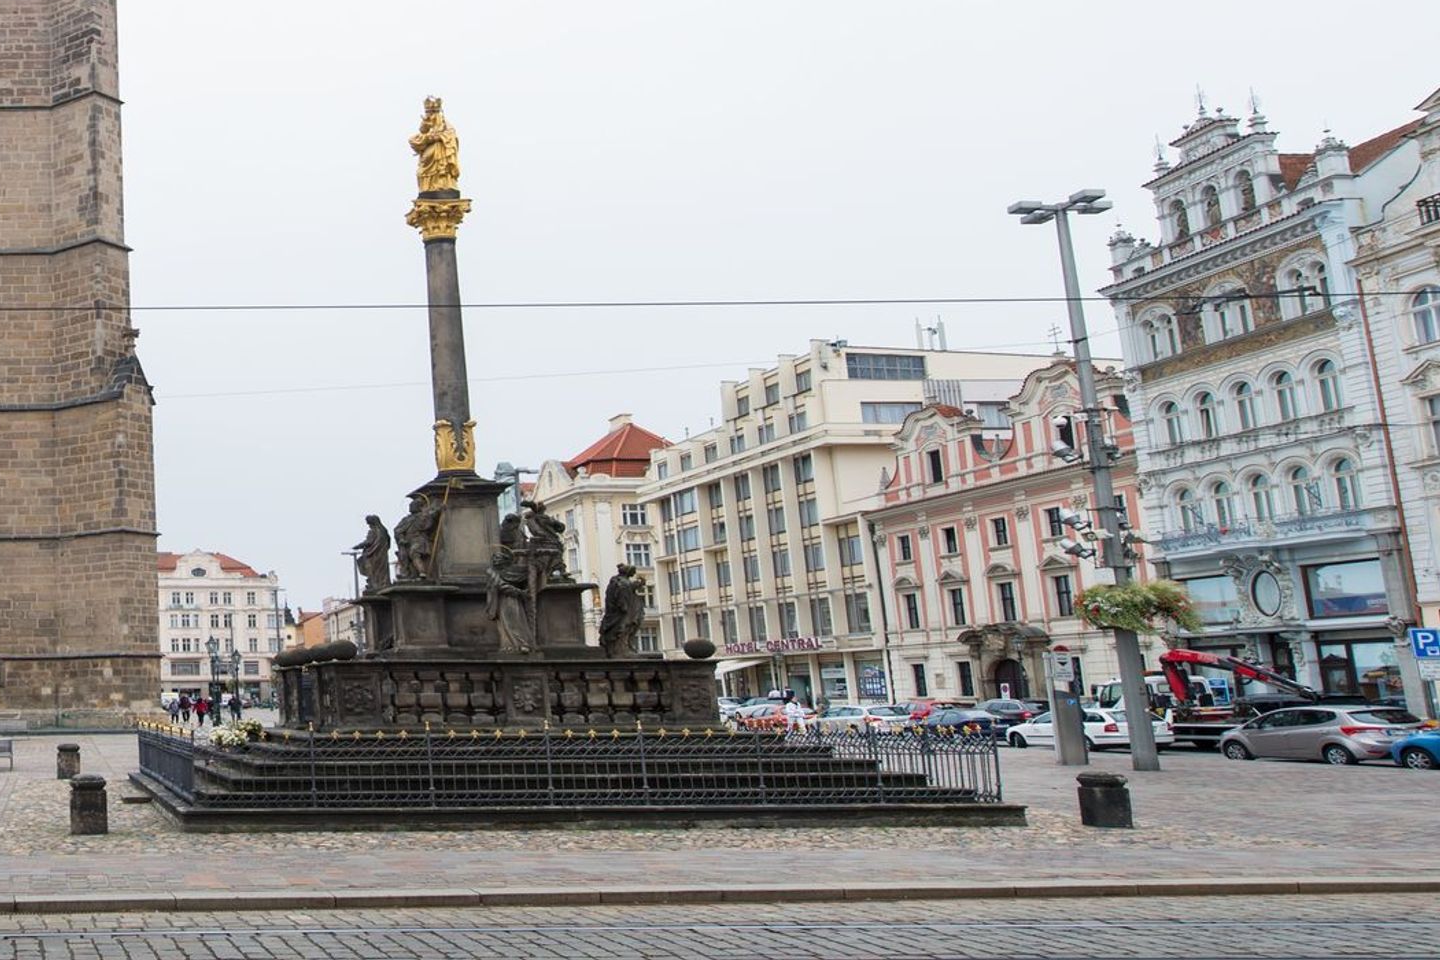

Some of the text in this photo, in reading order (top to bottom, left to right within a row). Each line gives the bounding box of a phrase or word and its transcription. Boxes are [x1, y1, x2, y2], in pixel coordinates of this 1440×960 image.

[725, 637, 822, 654] HOTEL CENTRAL
[1416, 632, 1434, 649] P
